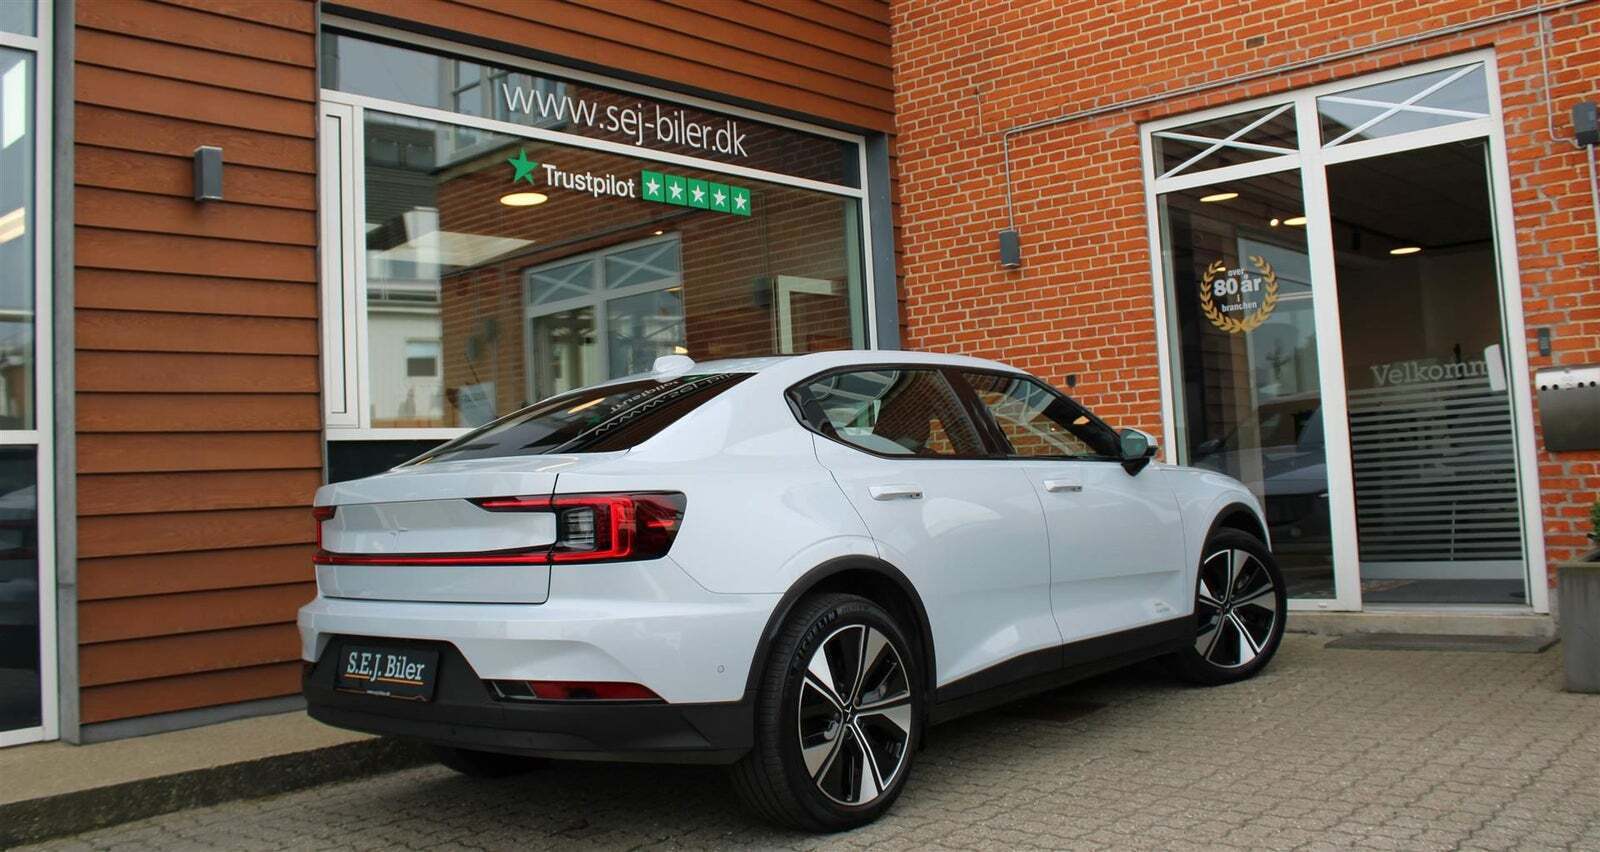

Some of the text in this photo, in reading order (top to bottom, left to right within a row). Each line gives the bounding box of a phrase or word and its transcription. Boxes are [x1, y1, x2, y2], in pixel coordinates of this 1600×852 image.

[502, 83, 748, 157] www.sej-biler.dk
[542, 163, 636, 198] Trustpilot
[1213, 274, 1262, 296] 80 år
[1228, 267, 1245, 277] over
[1221, 301, 1258, 313] branchen
[346, 652, 425, 682] S.E.J. Biler
